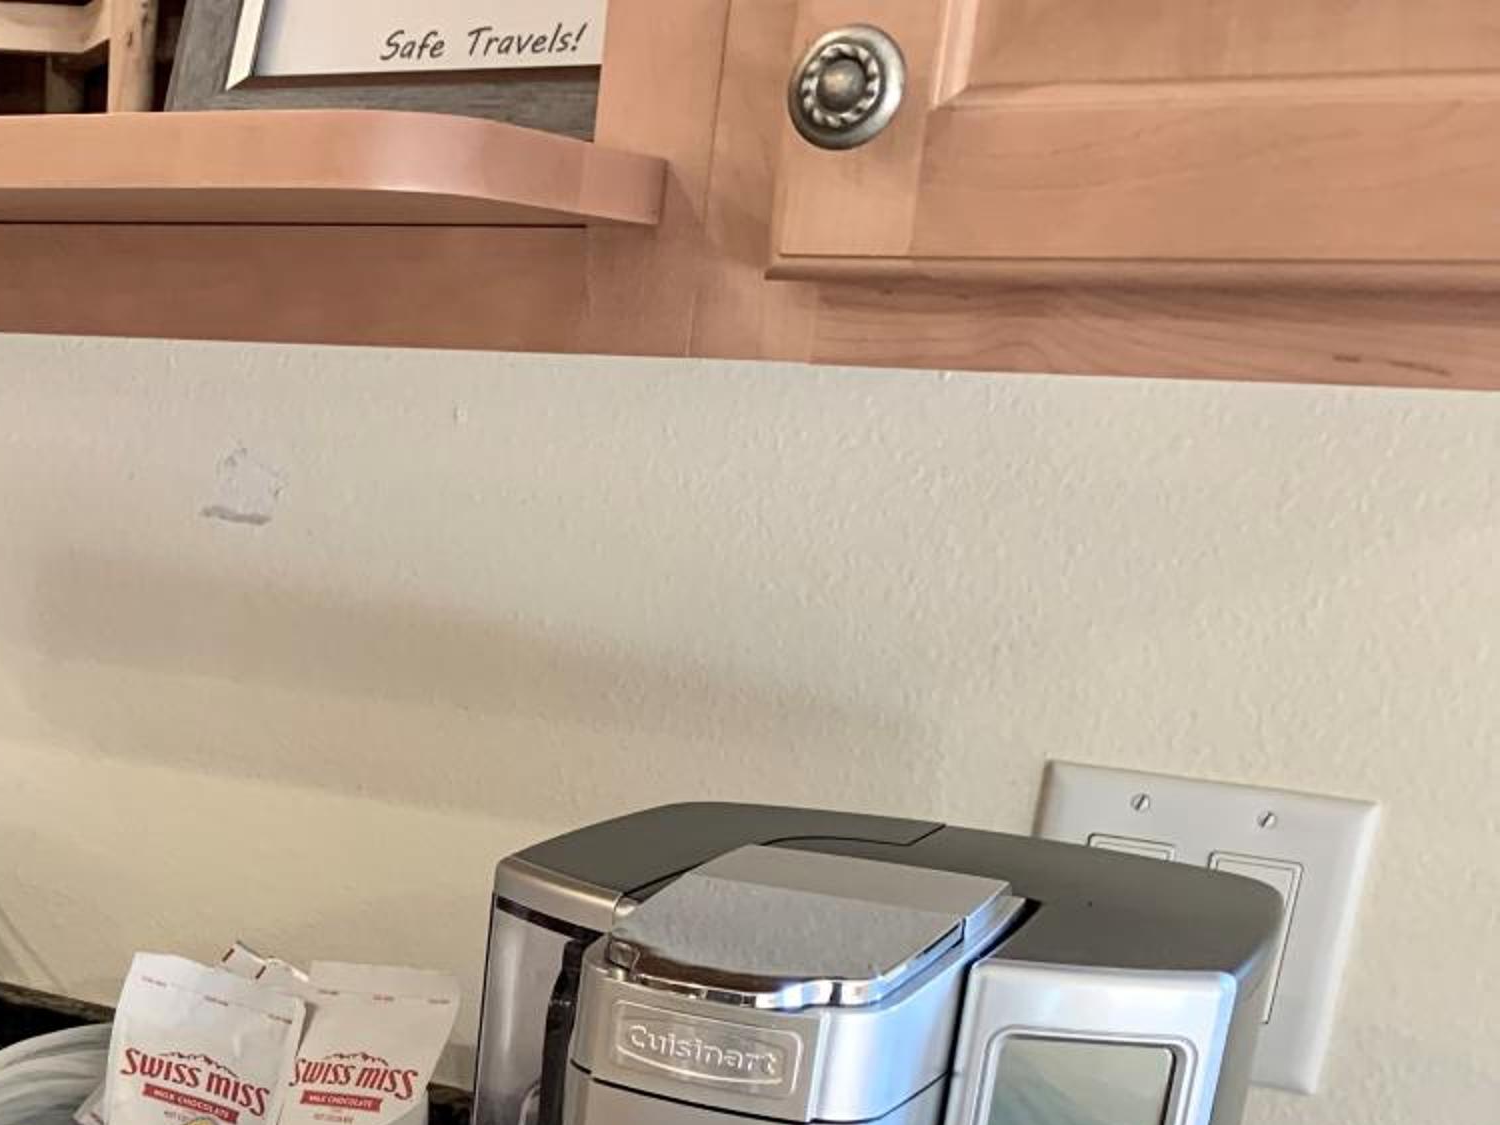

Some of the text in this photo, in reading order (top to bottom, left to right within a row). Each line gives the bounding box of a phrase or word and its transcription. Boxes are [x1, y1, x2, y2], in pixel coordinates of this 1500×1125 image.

[379, 22, 588, 61] Safe Travels!
[628, 1023, 778, 1076] Cuisinart
